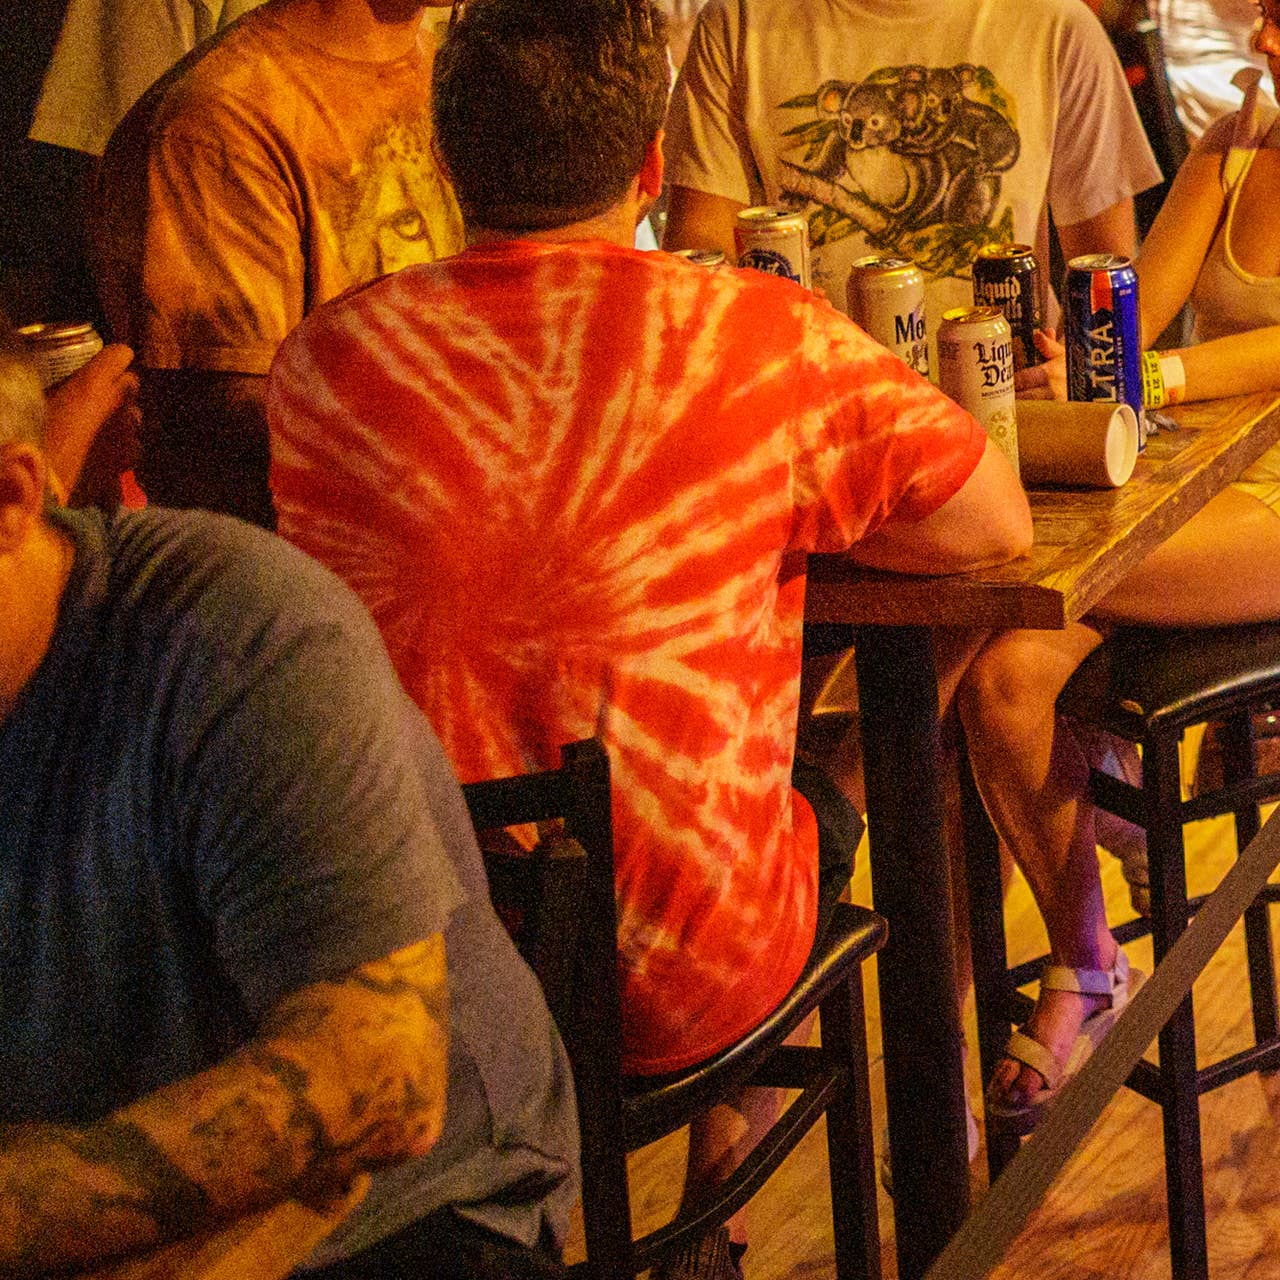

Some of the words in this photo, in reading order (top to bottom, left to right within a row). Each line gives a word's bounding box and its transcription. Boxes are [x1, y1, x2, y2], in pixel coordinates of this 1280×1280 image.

[894, 312, 926, 345] Mo
[973, 340, 1012, 366] Liqu
[1090, 320, 1117, 403] LTRA
[980, 364, 1013, 387] Dea
